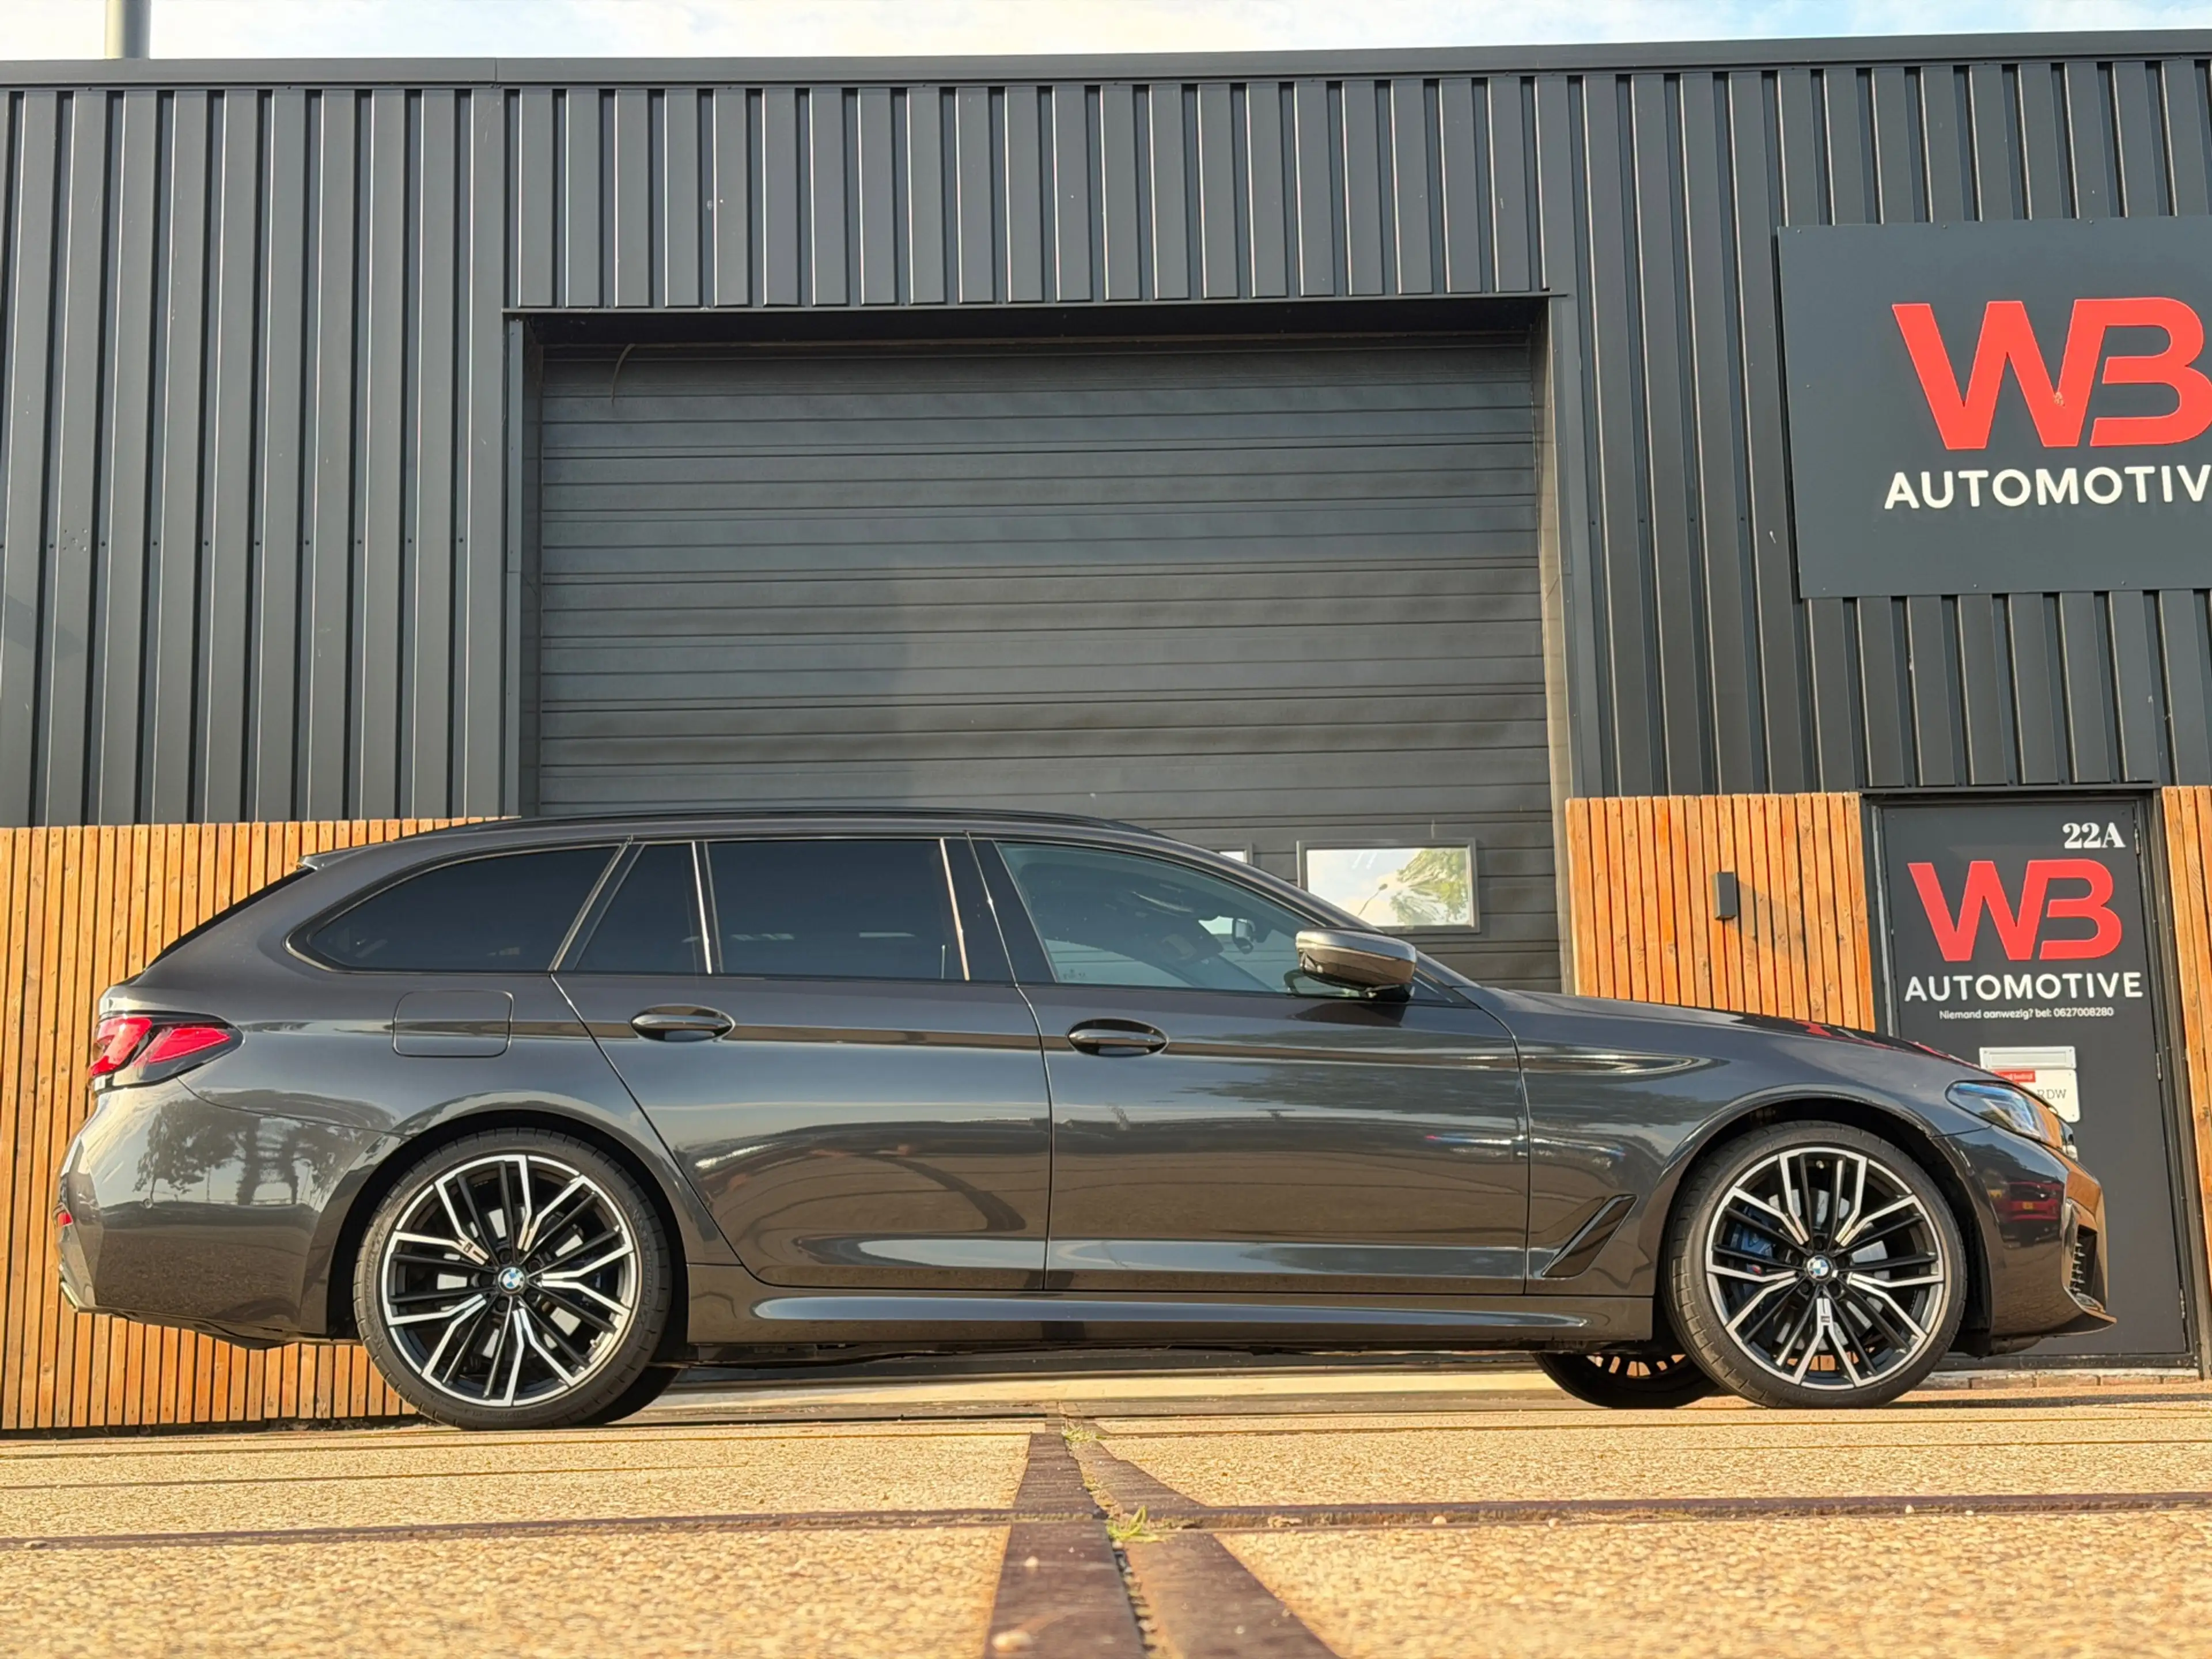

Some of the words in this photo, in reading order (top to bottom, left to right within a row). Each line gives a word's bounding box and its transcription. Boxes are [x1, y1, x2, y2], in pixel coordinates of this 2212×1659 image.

[1892, 297, 2212, 450] WB
[2062, 822, 2126, 849] 22A
[1908, 858, 2123, 962] WB
[1904, 972, 2143, 1002] AUTOMOTIVE
[1939, 1009, 1982, 1020] Niemand
[1983, 1008, 2033, 1020] aanwezig?
[2035, 1007, 2052, 1018] bel:
[2053, 1006, 2115, 1018] 0627008280
[2037, 1089, 2067, 1099] RDW
